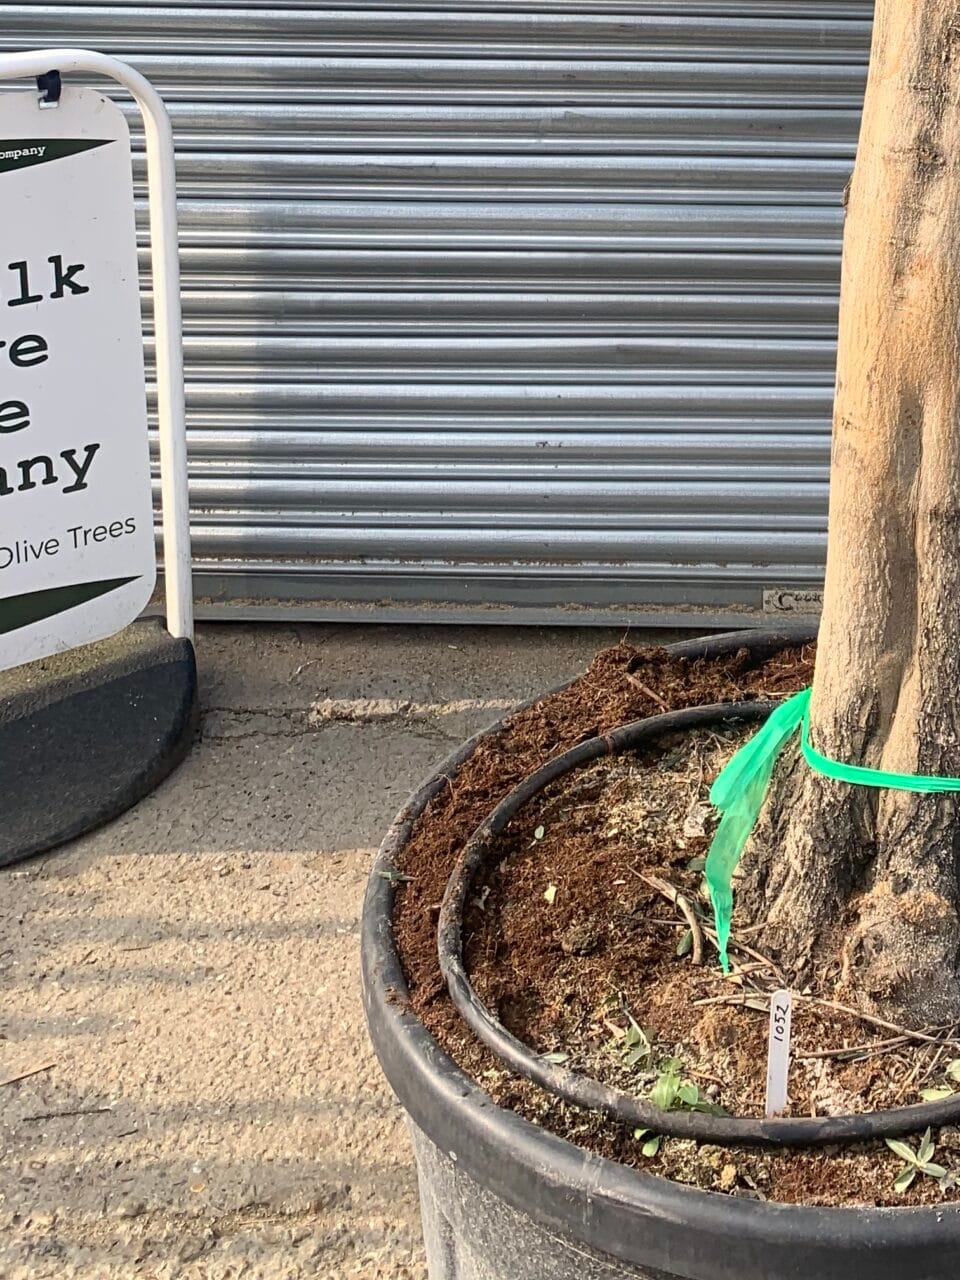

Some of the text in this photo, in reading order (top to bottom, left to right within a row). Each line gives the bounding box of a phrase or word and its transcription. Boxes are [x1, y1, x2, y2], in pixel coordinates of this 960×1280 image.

[7, 254, 90, 307] lk
[0, 334, 48, 368] e
[0, 517, 136, 569] Olive Trees
[773, 1004, 789, 1042] 1052
